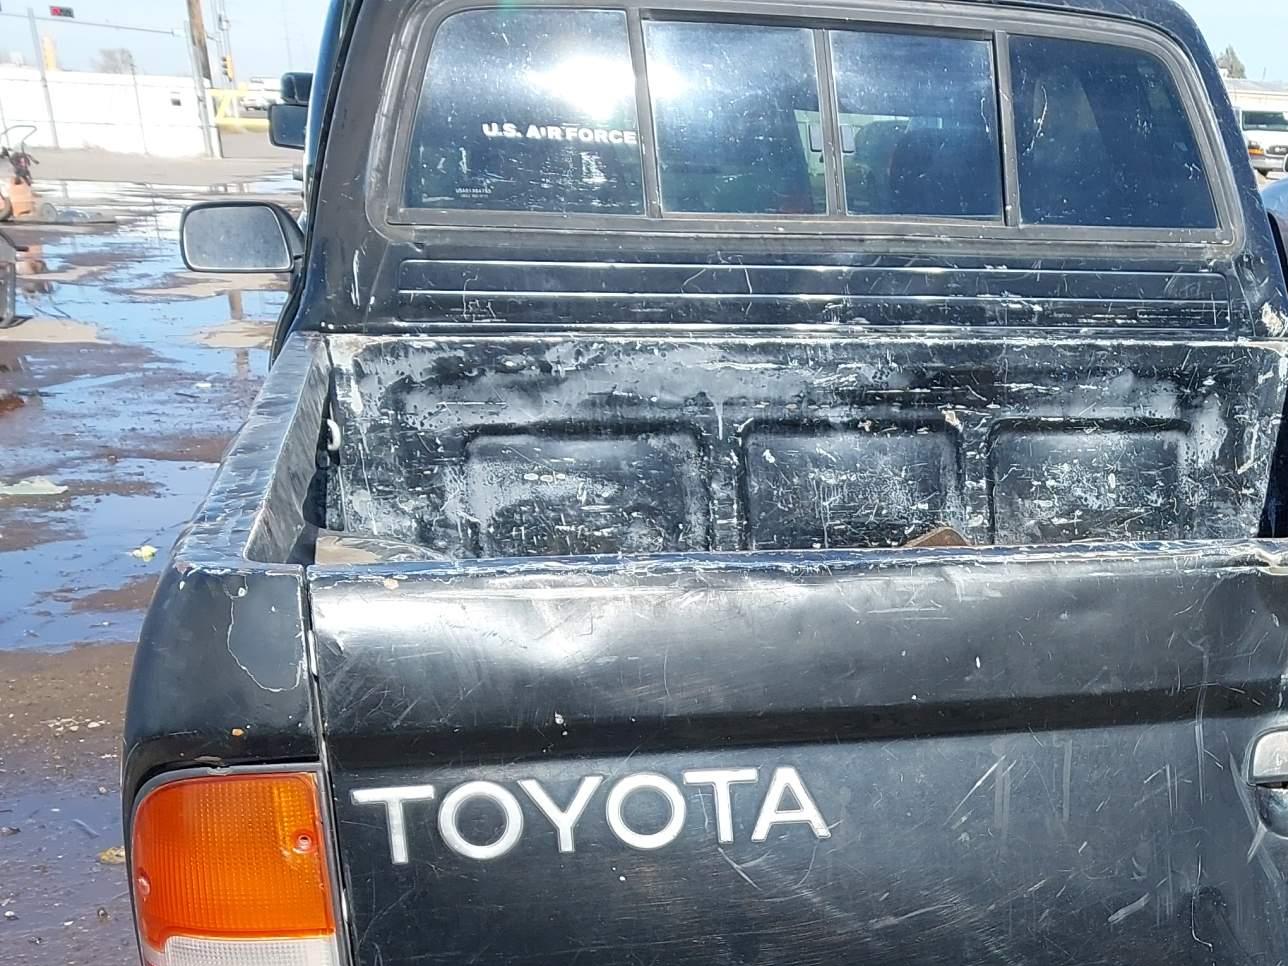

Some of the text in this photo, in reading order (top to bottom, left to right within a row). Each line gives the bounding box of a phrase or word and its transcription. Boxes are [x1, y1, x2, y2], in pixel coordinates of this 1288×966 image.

[482, 122, 638, 144] U.S. AIR FORCE
[351, 766, 831, 865] TOYOTA
